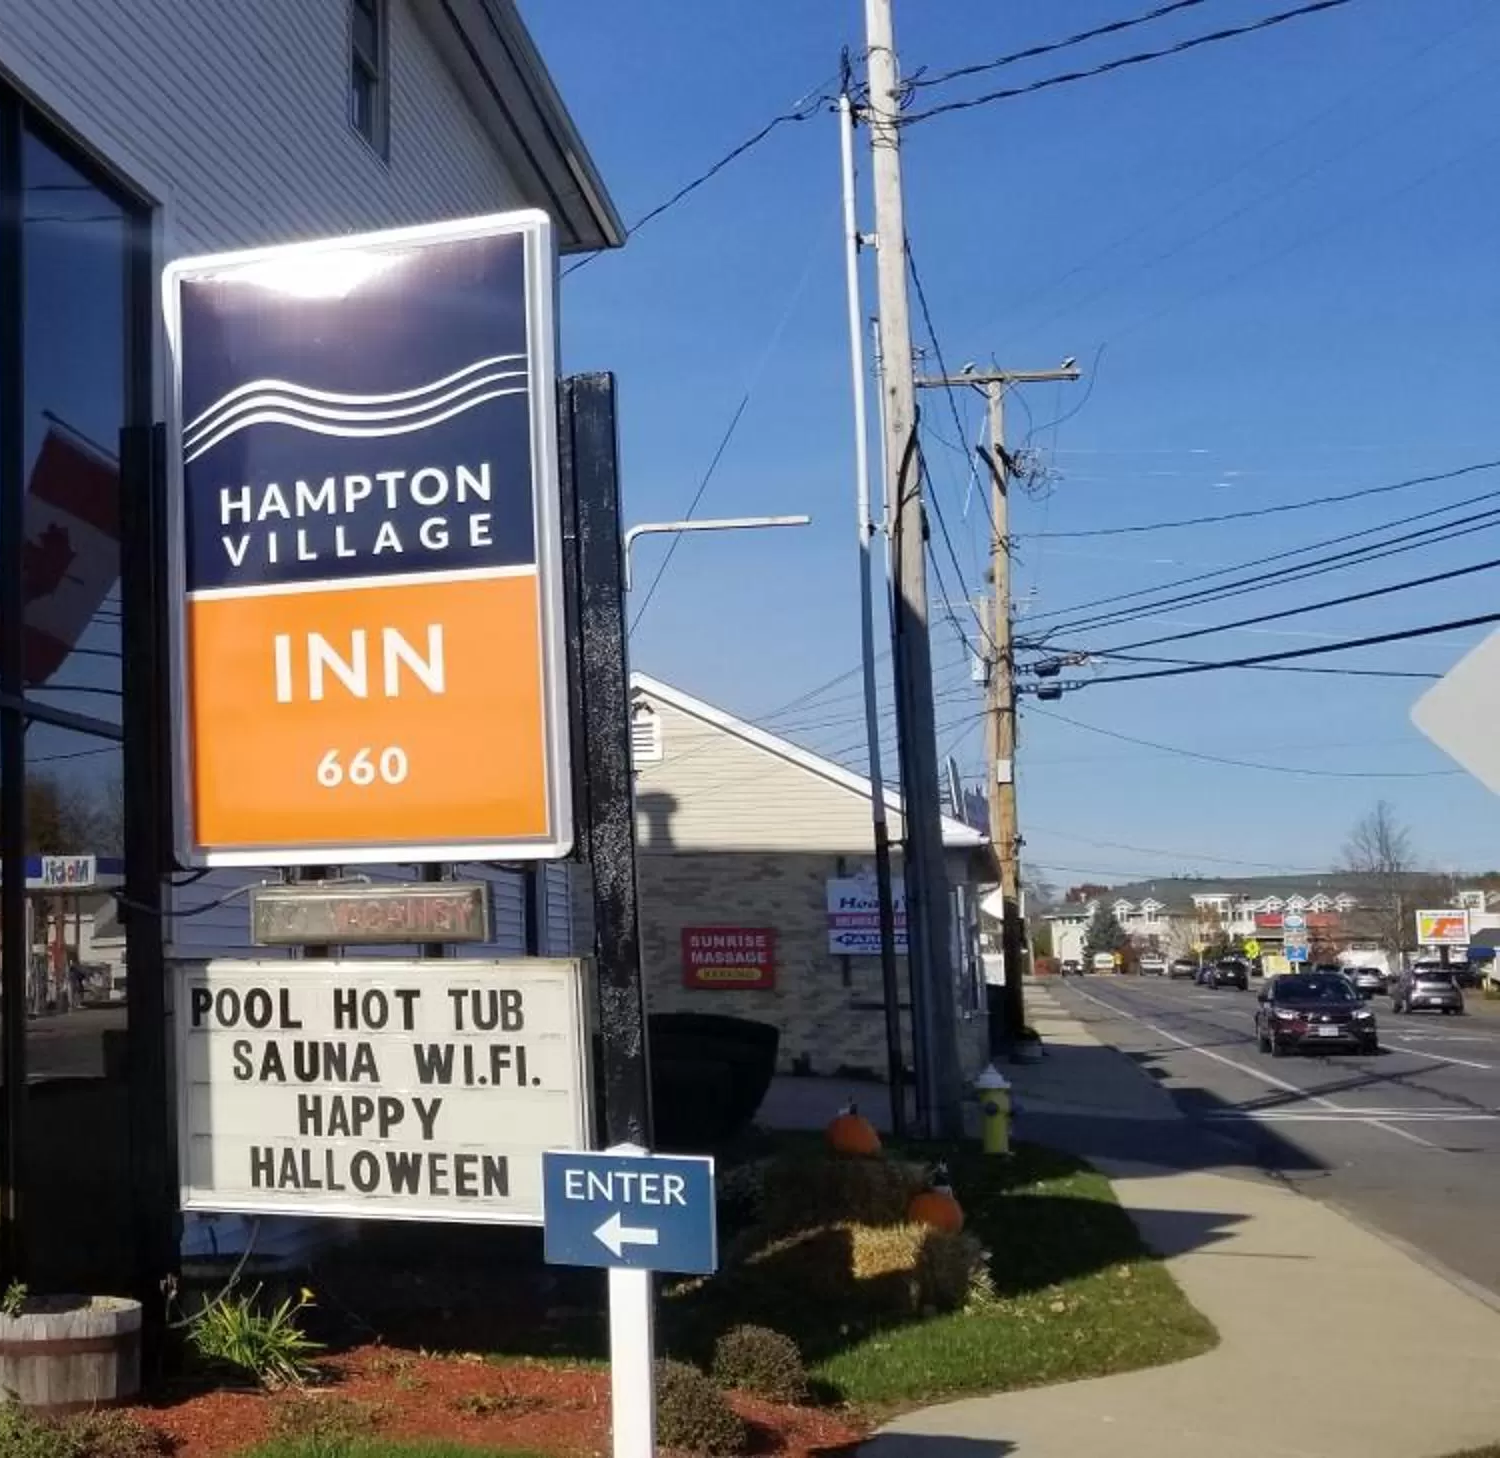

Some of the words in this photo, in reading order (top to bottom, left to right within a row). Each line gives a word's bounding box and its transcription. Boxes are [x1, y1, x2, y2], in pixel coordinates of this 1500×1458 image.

[220, 463, 492, 526] HAMPTON
[222, 513, 494, 567] VILLAGE
[274, 623, 446, 704] INN
[316, 745, 410, 788] 660
[691, 935, 767, 947] SUNRISE
[691, 952, 768, 965] MASSAGE
[191, 987, 303, 1030] POOL
[334, 988, 421, 1032] HOT
[448, 988, 525, 1032] TUB
[233, 1039, 381, 1083] SAUNA
[414, 1043, 542, 1087] WI.FI.
[298, 1094, 443, 1140] HAPPY
[250, 1146, 510, 1198] HALLOWEEN
[565, 1168, 687, 1207] ENTER
